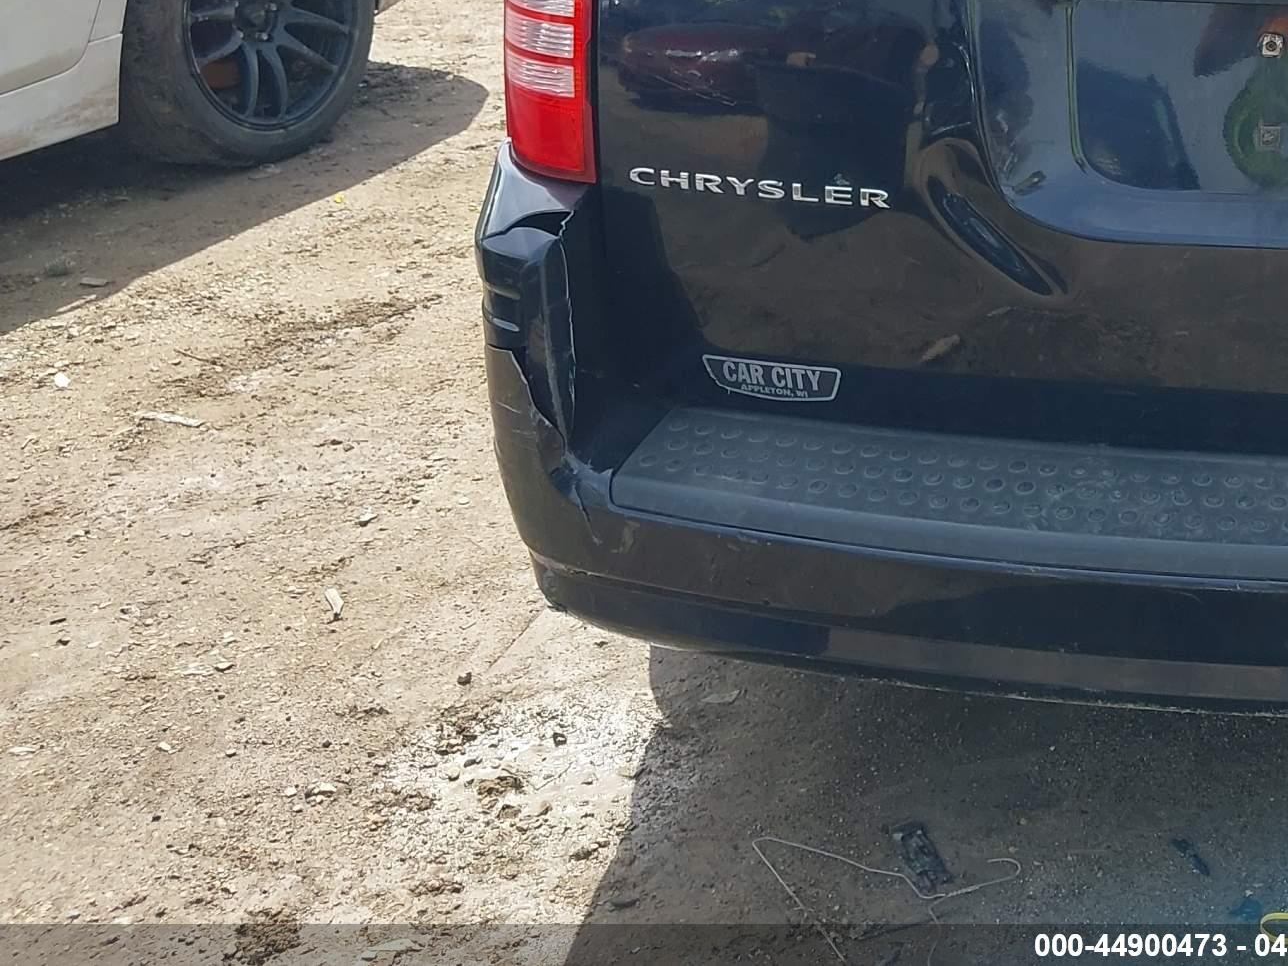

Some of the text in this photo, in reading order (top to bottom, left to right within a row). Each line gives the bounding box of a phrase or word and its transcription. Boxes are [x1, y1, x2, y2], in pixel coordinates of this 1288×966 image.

[629, 167, 891, 209] CHRYSLER
[722, 361, 821, 391] CAR CITY
[740, 384, 794, 397] APPLETON,
